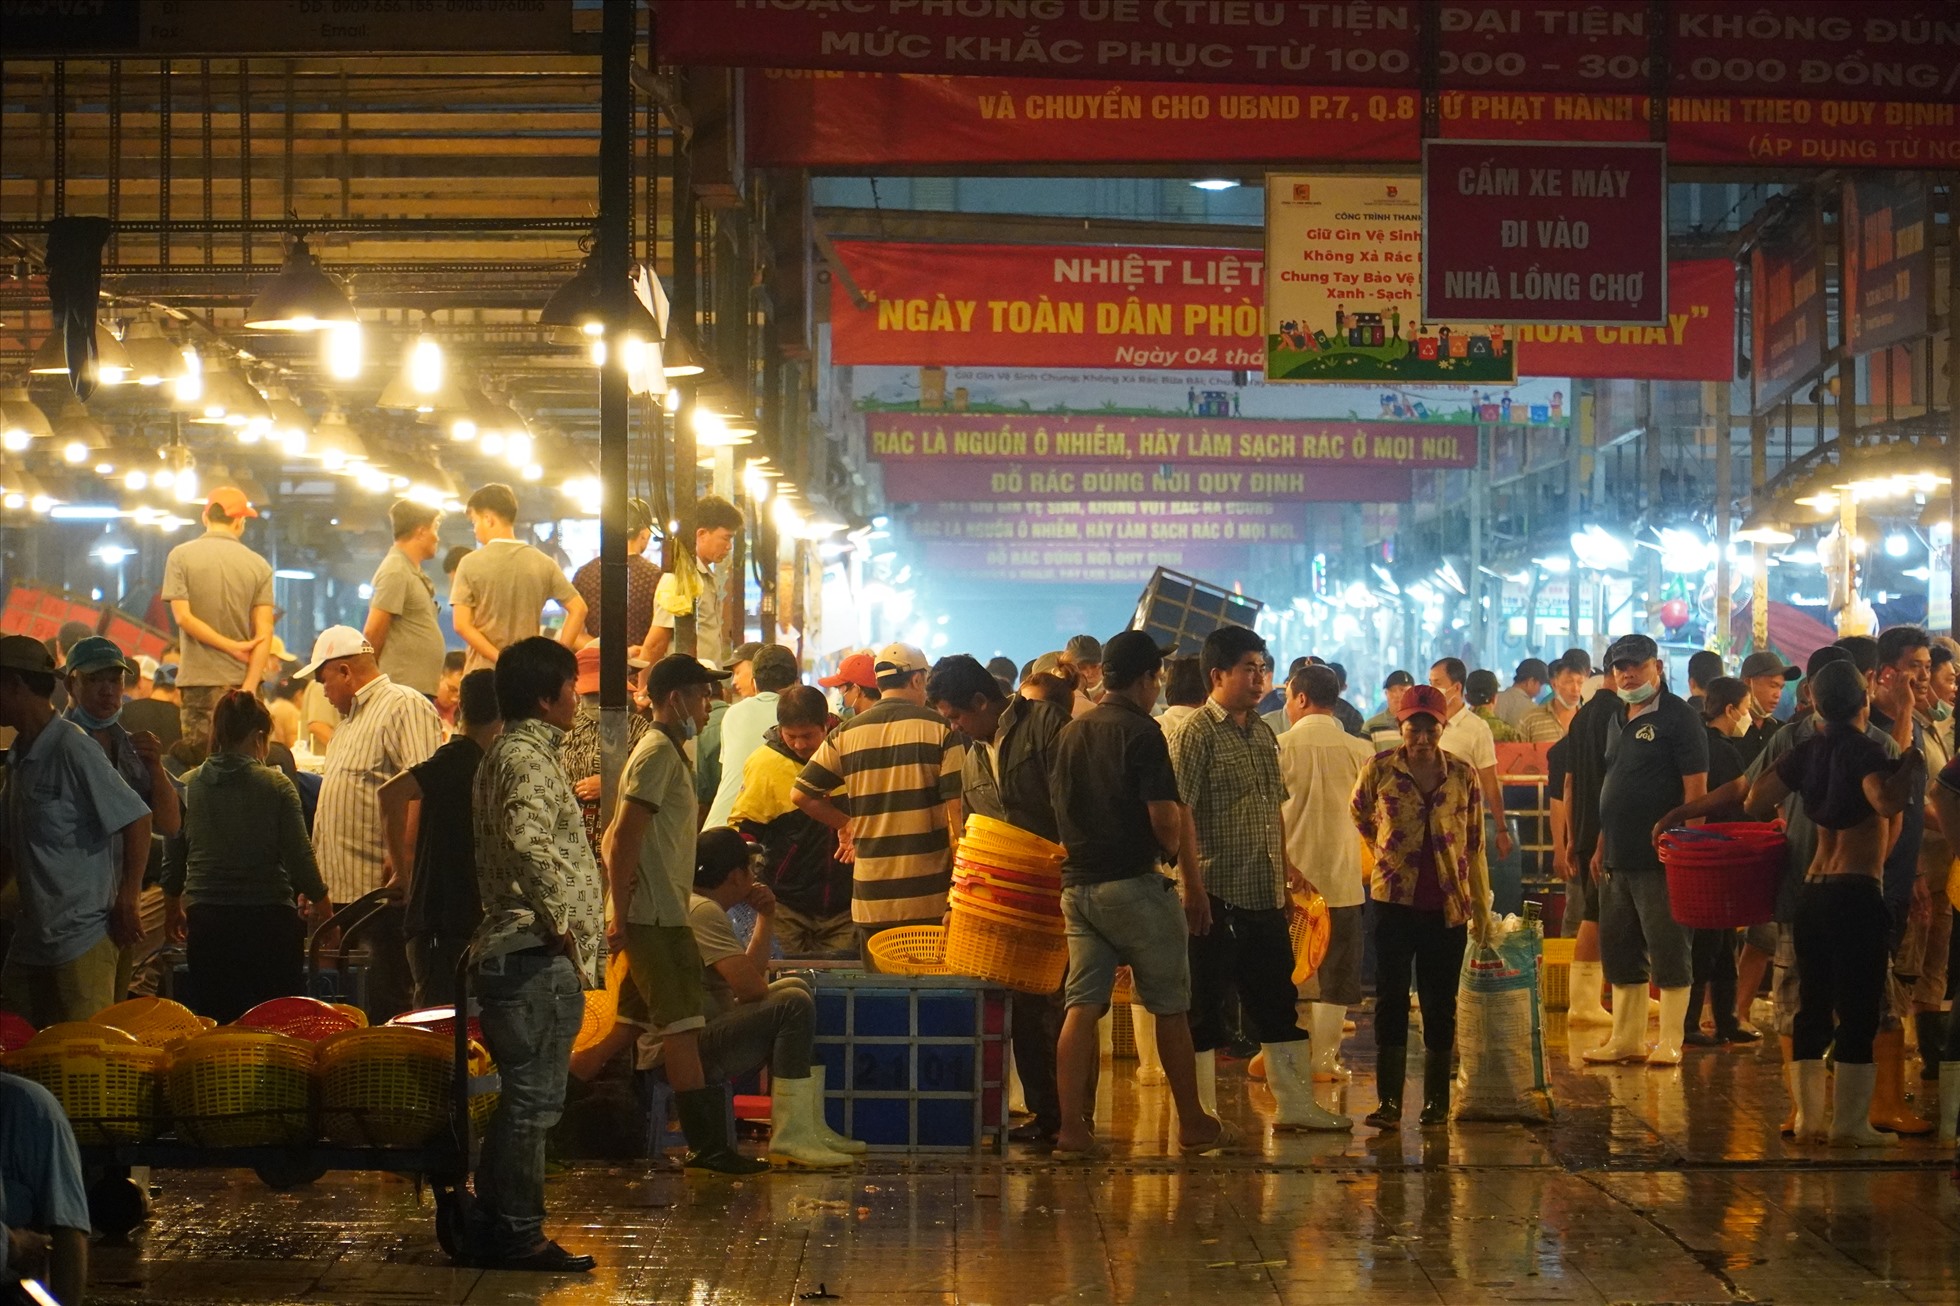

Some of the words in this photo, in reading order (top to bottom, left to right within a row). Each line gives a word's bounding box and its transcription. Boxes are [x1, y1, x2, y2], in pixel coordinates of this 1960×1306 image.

[1439, 8, 1520, 40] ĐẠI
[1678, 8, 1852, 41] KHÔNG
[821, 25, 932, 59] MỨC
[945, 25, 1084, 63] KHẮC
[1097, 39, 1233, 75] PHỤC
[1246, 38, 1316, 70] TỪ
[979, 91, 1016, 119] VÀ
[1025, 86, 1141, 119] CHUYỂN
[1151, 95, 1209, 120] CHO
[1220, 95, 1300, 120] UBND
[1309, 95, 1359, 122] P.7,
[1368, 95, 1414, 123] Q.8
[1428, 90, 1465, 120] Ử
[1471, 95, 1545, 125] PHẠT
[1554, 93, 1633, 121] HÀNH
[1740, 99, 1812, 124] THEO
[1820, 101, 1876, 127] QUY
[1884, 101, 1954, 130] ĐỊNH
[1802, 139, 1877, 161] DỤNG
[1886, 136, 1920, 160] TỪ
[1458, 158, 1519, 196] CẤM
[1528, 168, 1562, 196] XE
[1572, 164, 1630, 198] MÁY
[1334, 211, 1361, 221] CÔNG
[1363, 211, 1390, 221] TRÌNH
[1501, 220, 1527, 248] ĐI
[1537, 215, 1589, 249] VÀO
[1306, 228, 1332, 240] Giữ
[1335, 228, 1361, 241] Gìn
[1366, 230, 1385, 243] Vệ
[1389, 230, 1422, 241] Sinh
[1053, 253, 1172, 292] NHIỆT
[1182, 255, 1264, 293] LIỆT
[1304, 250, 1354, 264] Không
[1360, 250, 1379, 262] Xả
[1384, 251, 1413, 262] Rác
[1281, 271, 1329, 284] Chung
[1333, 272, 1359, 285] Tay
[1363, 271, 1392, 283] Bảo
[1396, 273, 1415, 286] Vệ
[1327, 288, 1365, 299] Xanh
[1377, 289, 1412, 301] Sạch
[1445, 265, 1501, 299] NHÀ
[1510, 263, 1580, 301] LỒNG
[1589, 271, 1644, 308] CHỢ
[988, 292, 1084, 335] TOÀN
[1096, 296, 1172, 336] DÂN
[1184, 297, 1264, 337] PHÒ
[1115, 346, 1177, 368] Ngày
[1184, 348, 1217, 364] 04
[872, 426, 914, 454] RÁC
[922, 426, 947, 454] LÀ
[1034, 427, 1048, 455] Ô
[1138, 428, 1181, 456] HÃY
[1187, 428, 1232, 457] LÀM
[1239, 432, 1295, 461] SẠCH
[1303, 429, 1345, 459] RÁC
[1352, 429, 1368, 459] Ở
[1373, 435, 1415, 464] MỌI
[1029, 468, 1075, 493] RÁC
[1082, 467, 1144, 493] ĐÚNG
[1198, 472, 1243, 494] QUY
[1250, 472, 1304, 496] ĐỊNH
